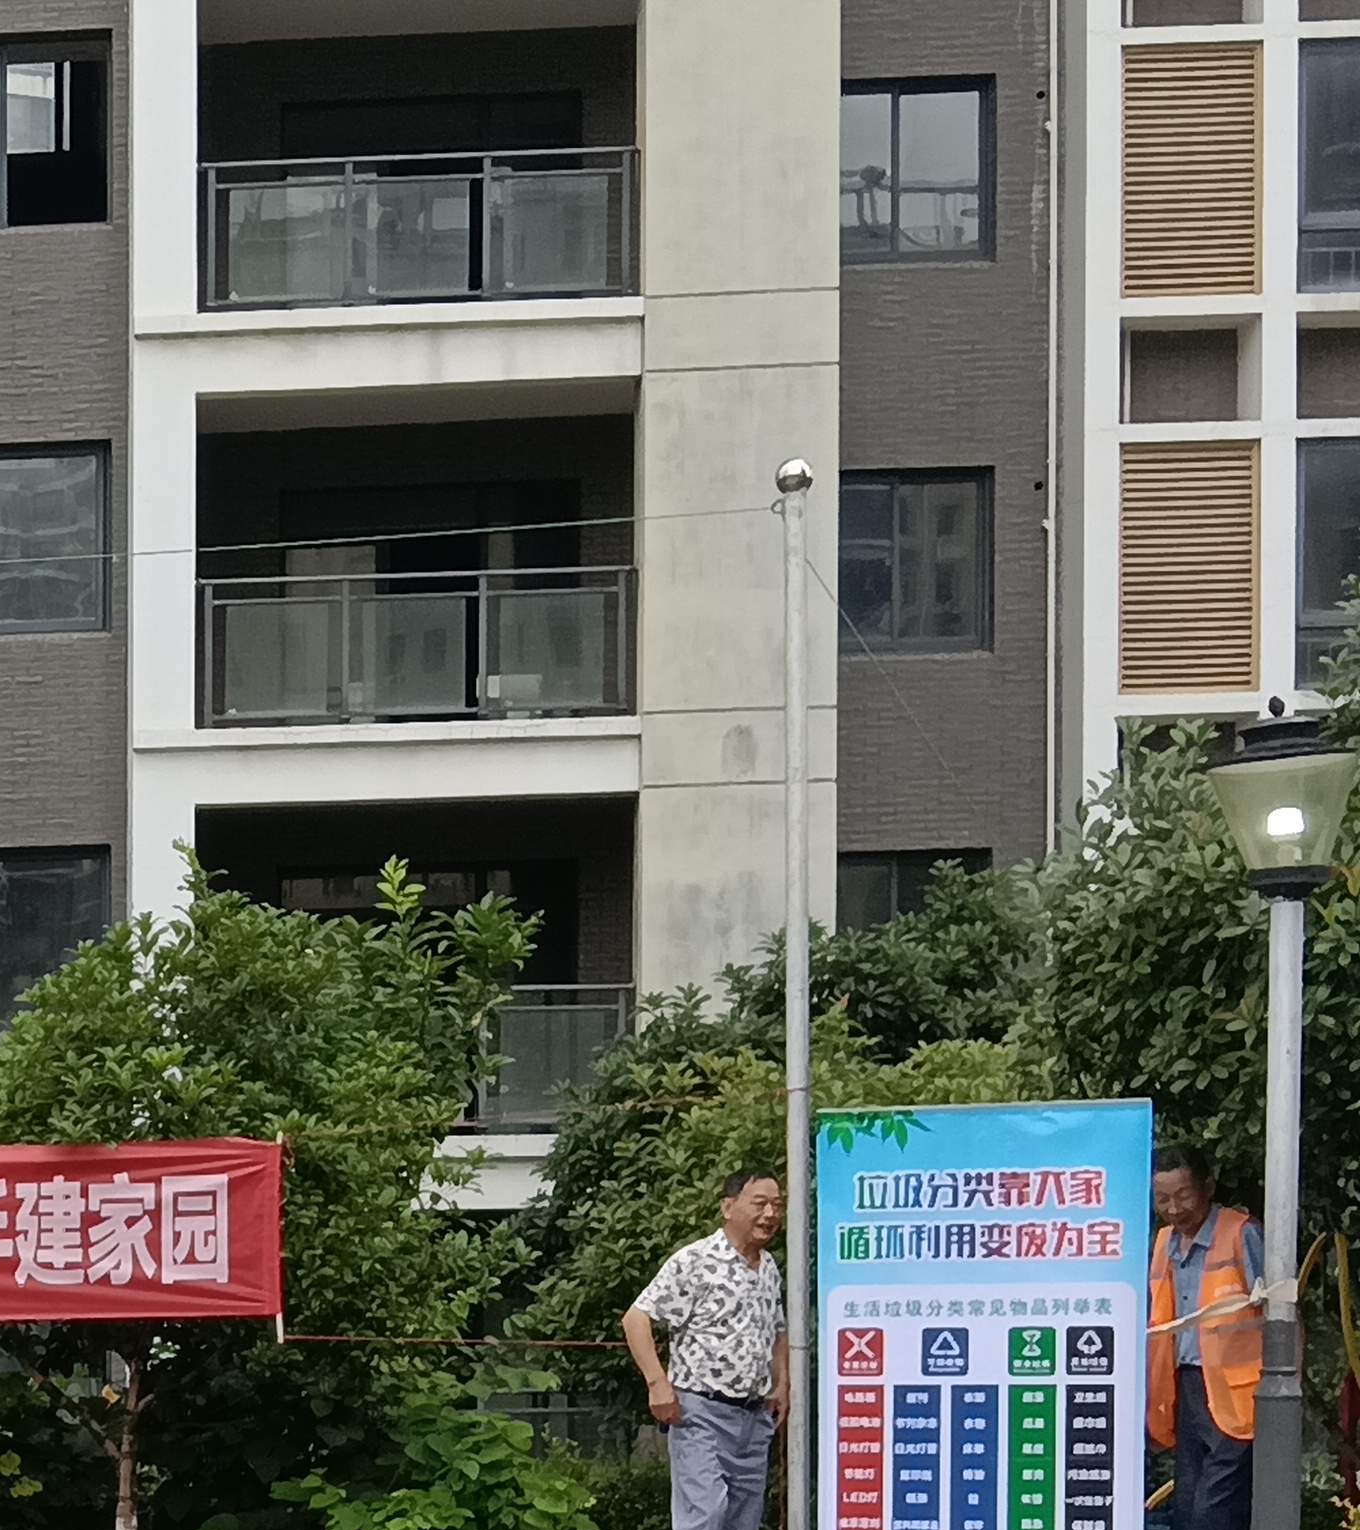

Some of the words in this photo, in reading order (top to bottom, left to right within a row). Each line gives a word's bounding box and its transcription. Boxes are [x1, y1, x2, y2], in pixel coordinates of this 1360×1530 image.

[855, 1169, 1104, 1210] 垃圾分类靠大家
[838, 1220, 1122, 1261] 循环利用变废为宝
